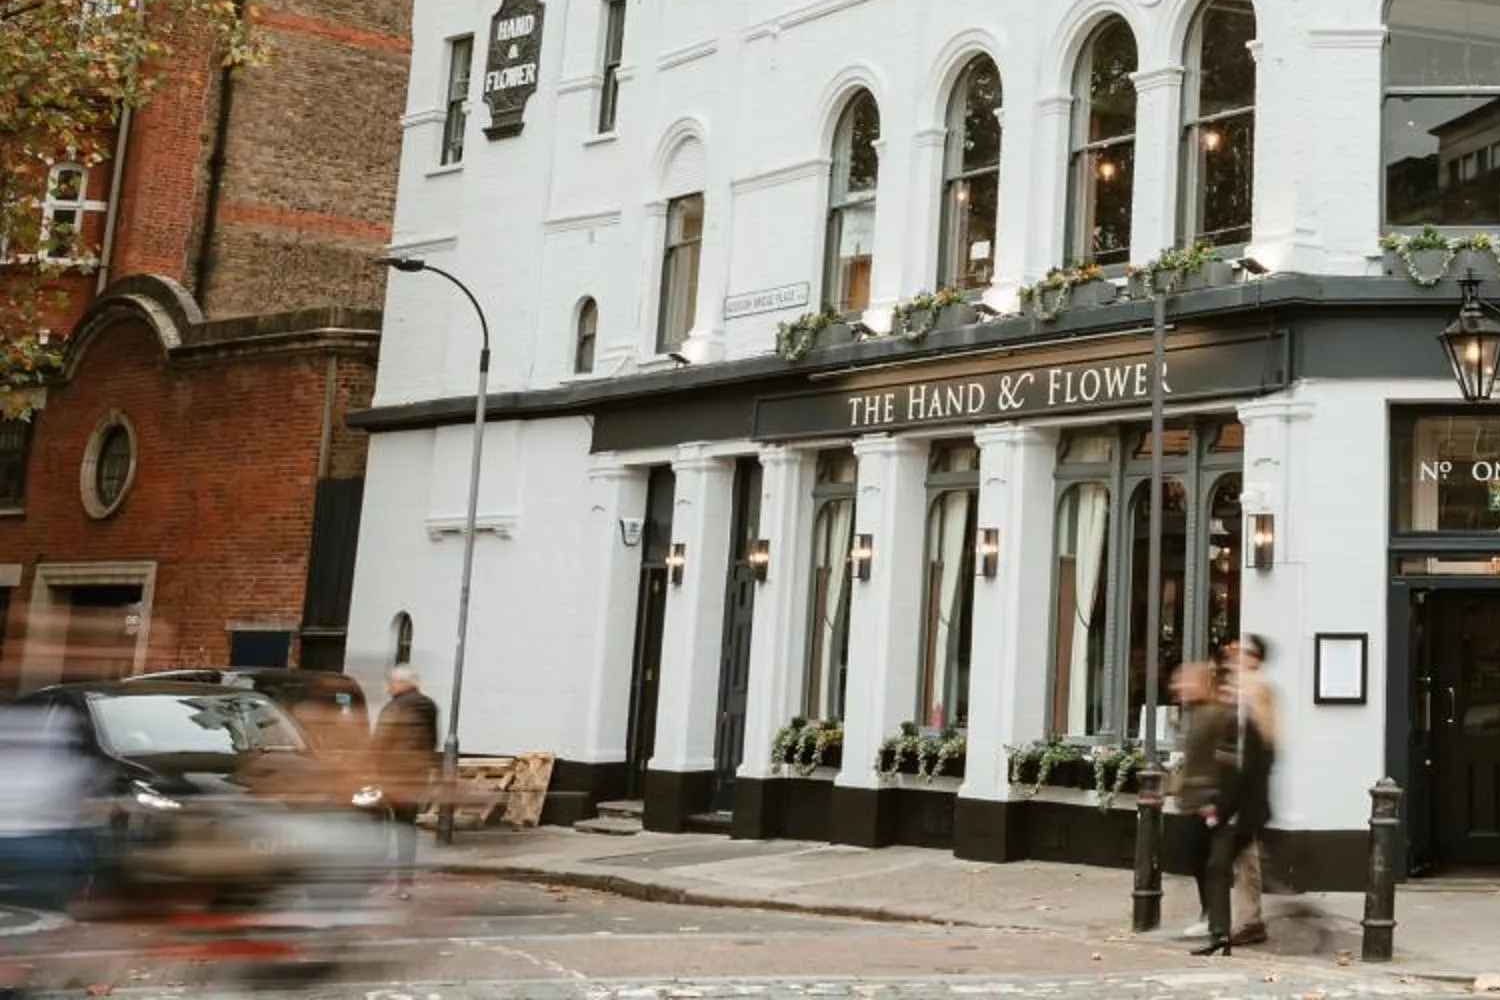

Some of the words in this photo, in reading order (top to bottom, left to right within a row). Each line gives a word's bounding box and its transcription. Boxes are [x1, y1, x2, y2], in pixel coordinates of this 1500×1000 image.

[497, 14, 535, 41] HAND
[485, 62, 537, 93] FLOWER
[848, 393, 895, 426] THE
[907, 383, 985, 420] HAND
[999, 372, 1035, 411] &
